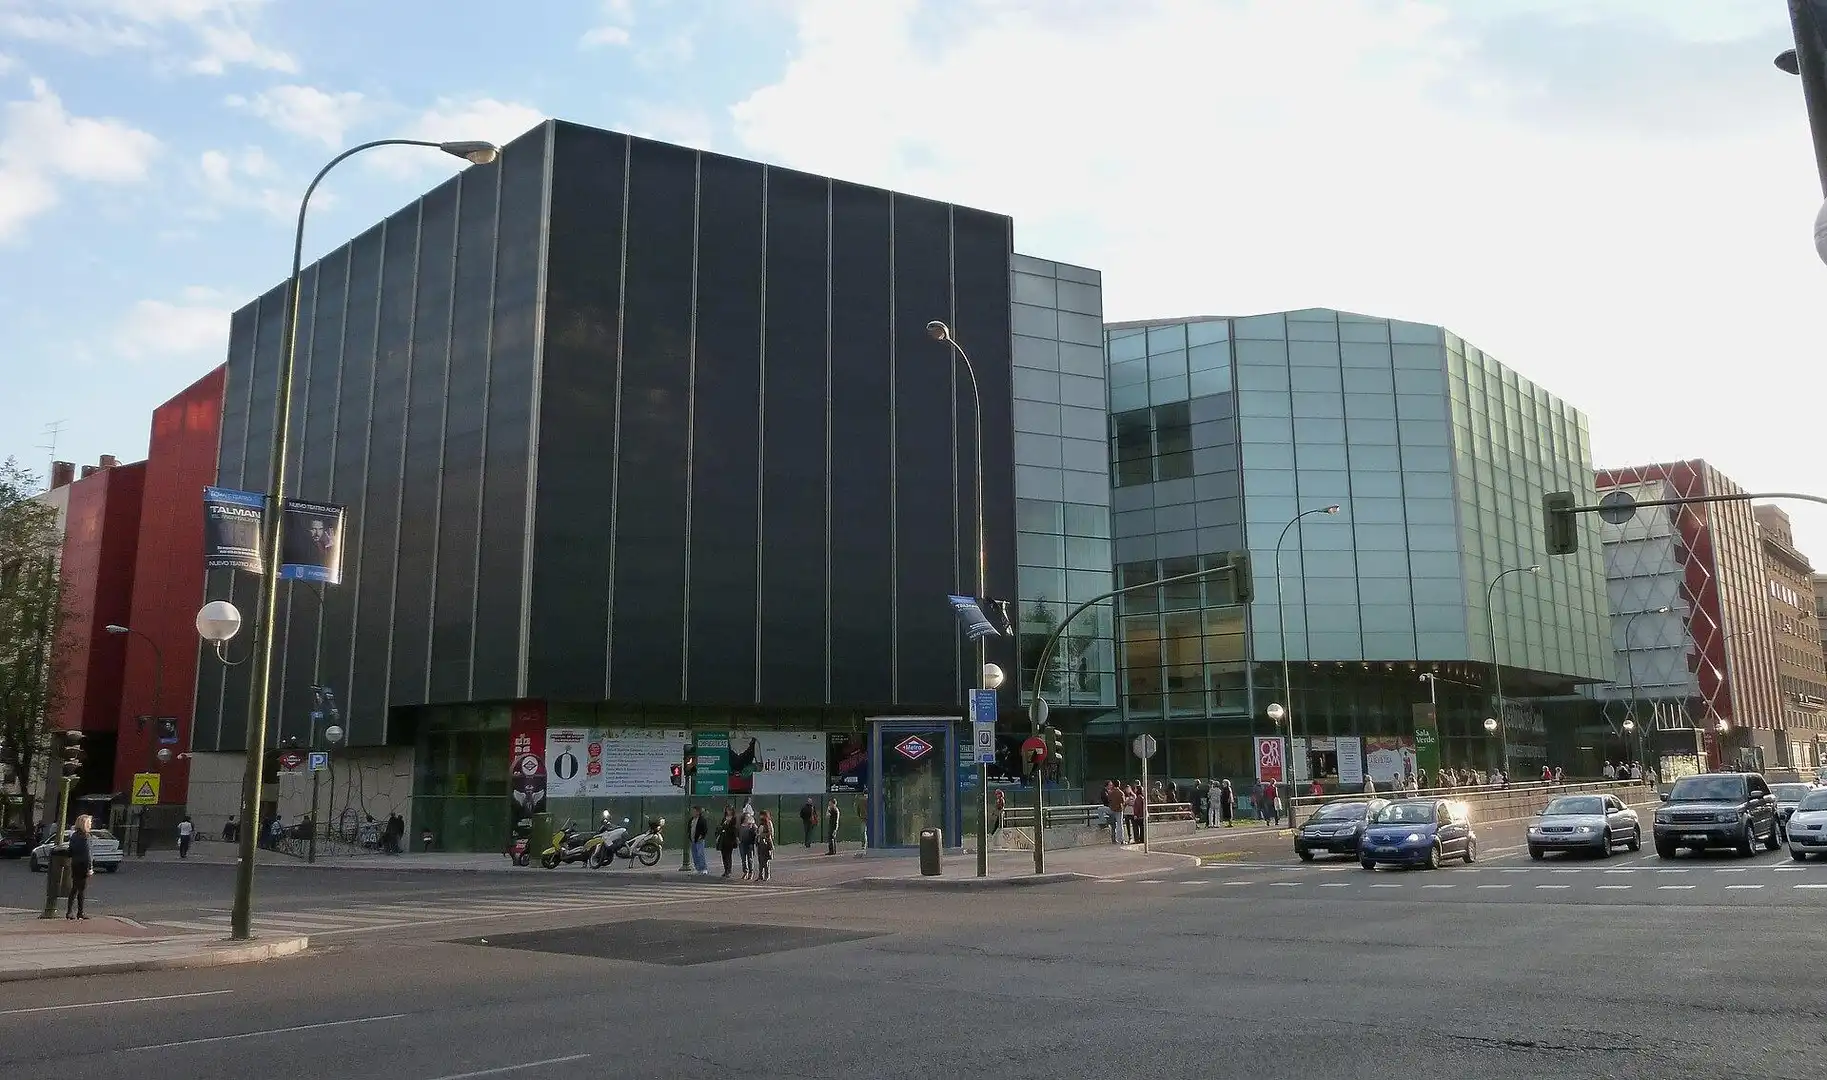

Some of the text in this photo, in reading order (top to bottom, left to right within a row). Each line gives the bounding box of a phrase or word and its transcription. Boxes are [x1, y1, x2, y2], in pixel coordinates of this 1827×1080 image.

[209, 506, 261, 519] TALMAN
[1415, 729, 1429, 737] Sala
[1415, 735, 1435, 743] Verde
[905, 743, 922, 751] Metro
[1260, 741, 1280, 757] OR
[312, 754, 324, 769] P
[764, 758, 776, 771] de
[778, 758, 791, 771] los
[793, 757, 825, 771] nervios
[1261, 755, 1281, 767] CAM
